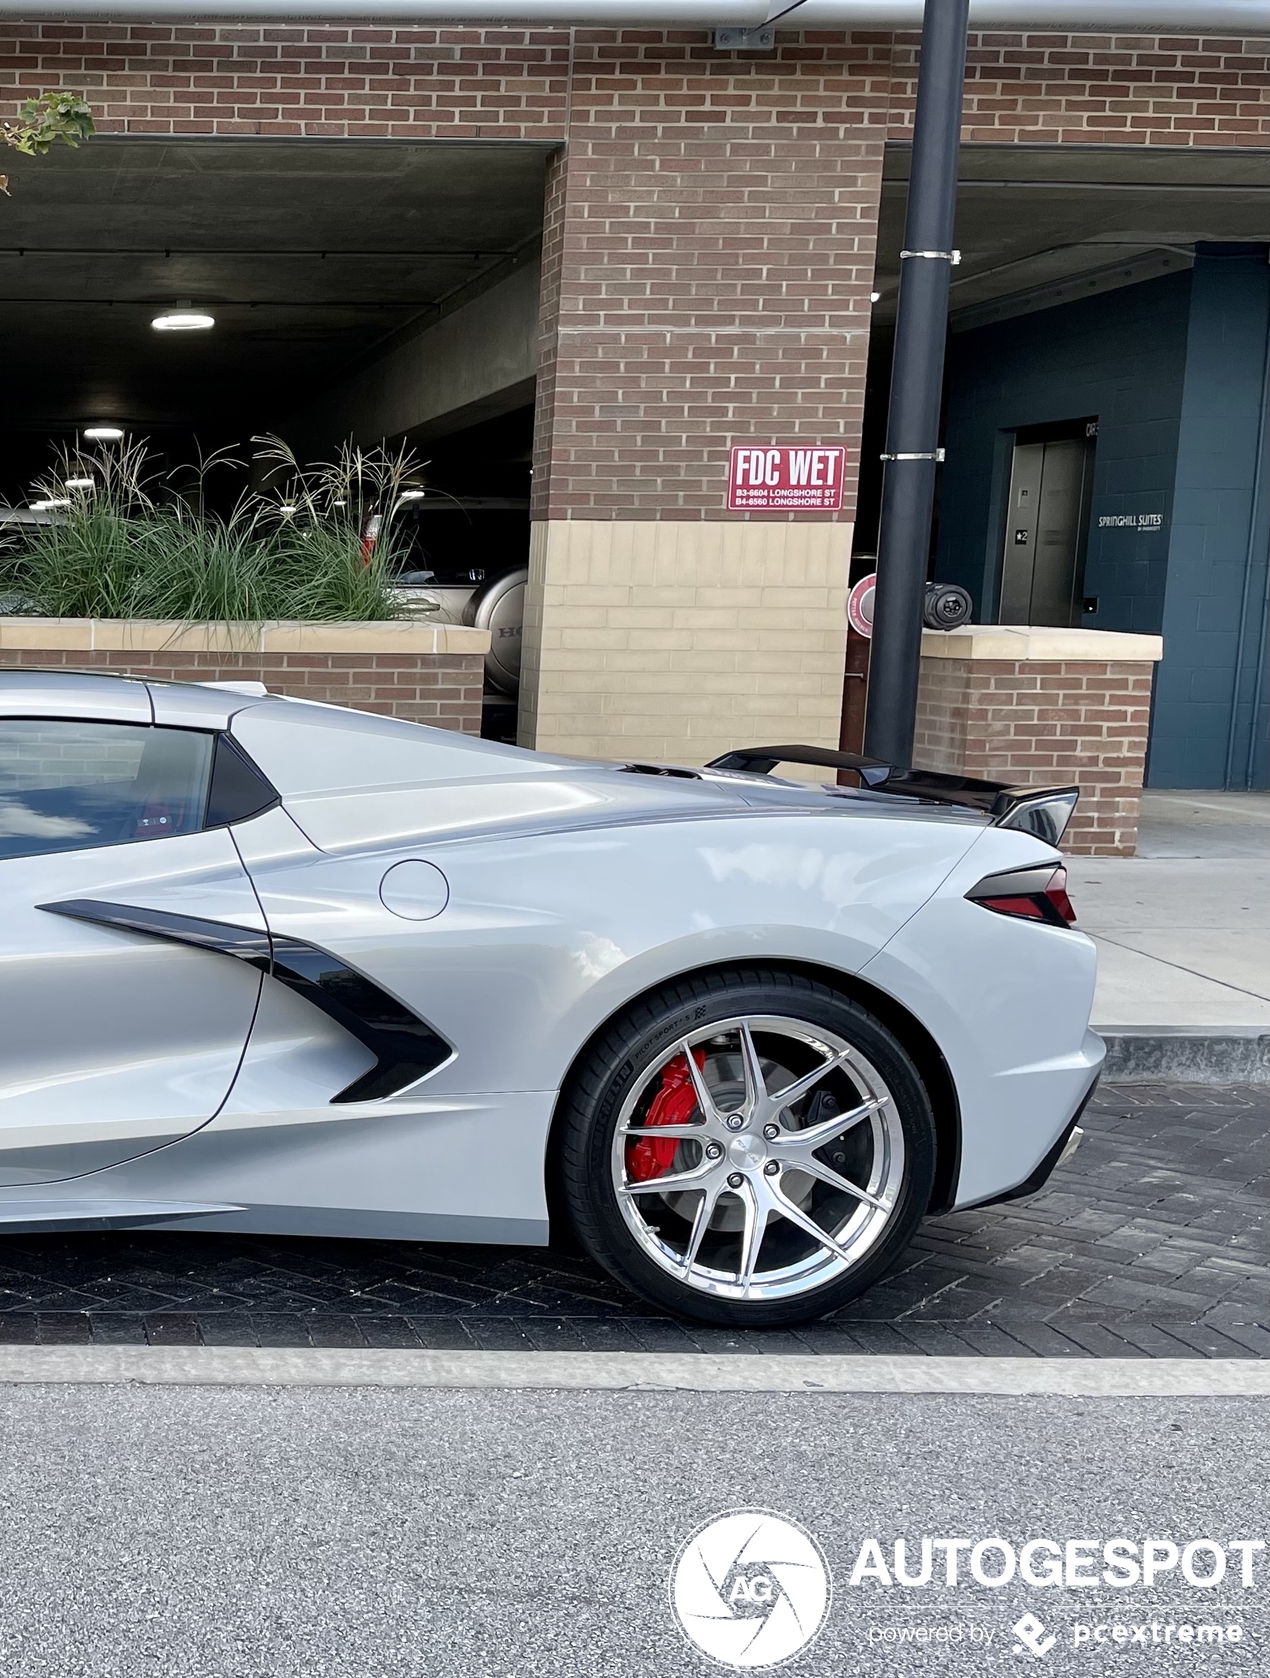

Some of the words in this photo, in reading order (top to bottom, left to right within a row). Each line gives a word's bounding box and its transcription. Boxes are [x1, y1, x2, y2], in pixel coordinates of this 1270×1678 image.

[736, 450, 781, 486] FDC
[789, 450, 840, 486] WET
[735, 497, 768, 506] B4-6560
[769, 497, 822, 506] LONGSHORE
[824, 497, 835, 506] ST
[736, 489, 768, 497] B3-6604
[770, 489, 822, 497] LONGSHORE
[824, 489, 836, 497] ST
[1098, 515, 1137, 527] SPRINGHILL
[1138, 514, 1162, 526] SUITES
[634, 1038, 653, 1059] PILOT
[654, 1020, 678, 1041] SPORT
[593, 1064, 631, 1148] MICHELIN
